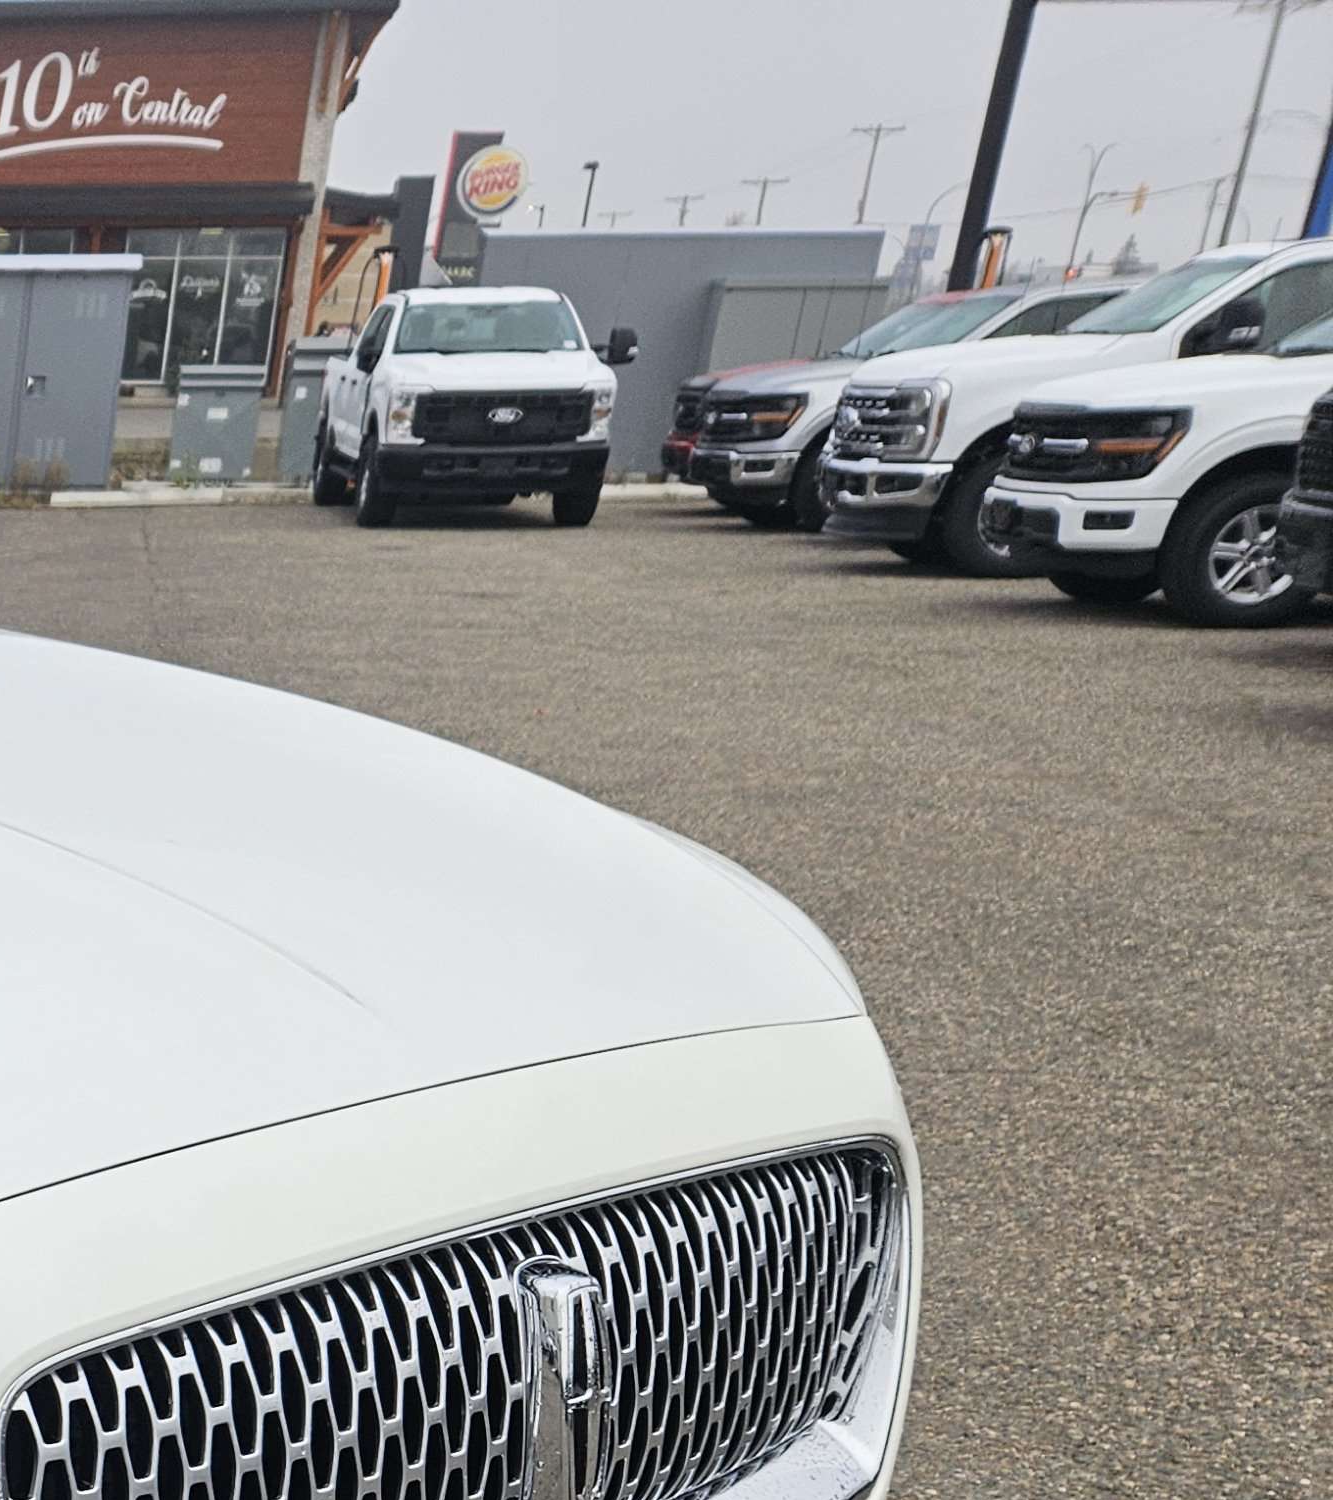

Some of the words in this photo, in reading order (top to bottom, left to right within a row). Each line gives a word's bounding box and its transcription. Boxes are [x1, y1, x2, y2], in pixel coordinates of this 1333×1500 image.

[71, 101, 109, 129] on
[112, 76, 227, 129] Central
[468, 161, 521, 182] BURGER
[468, 174, 519, 199] KING
